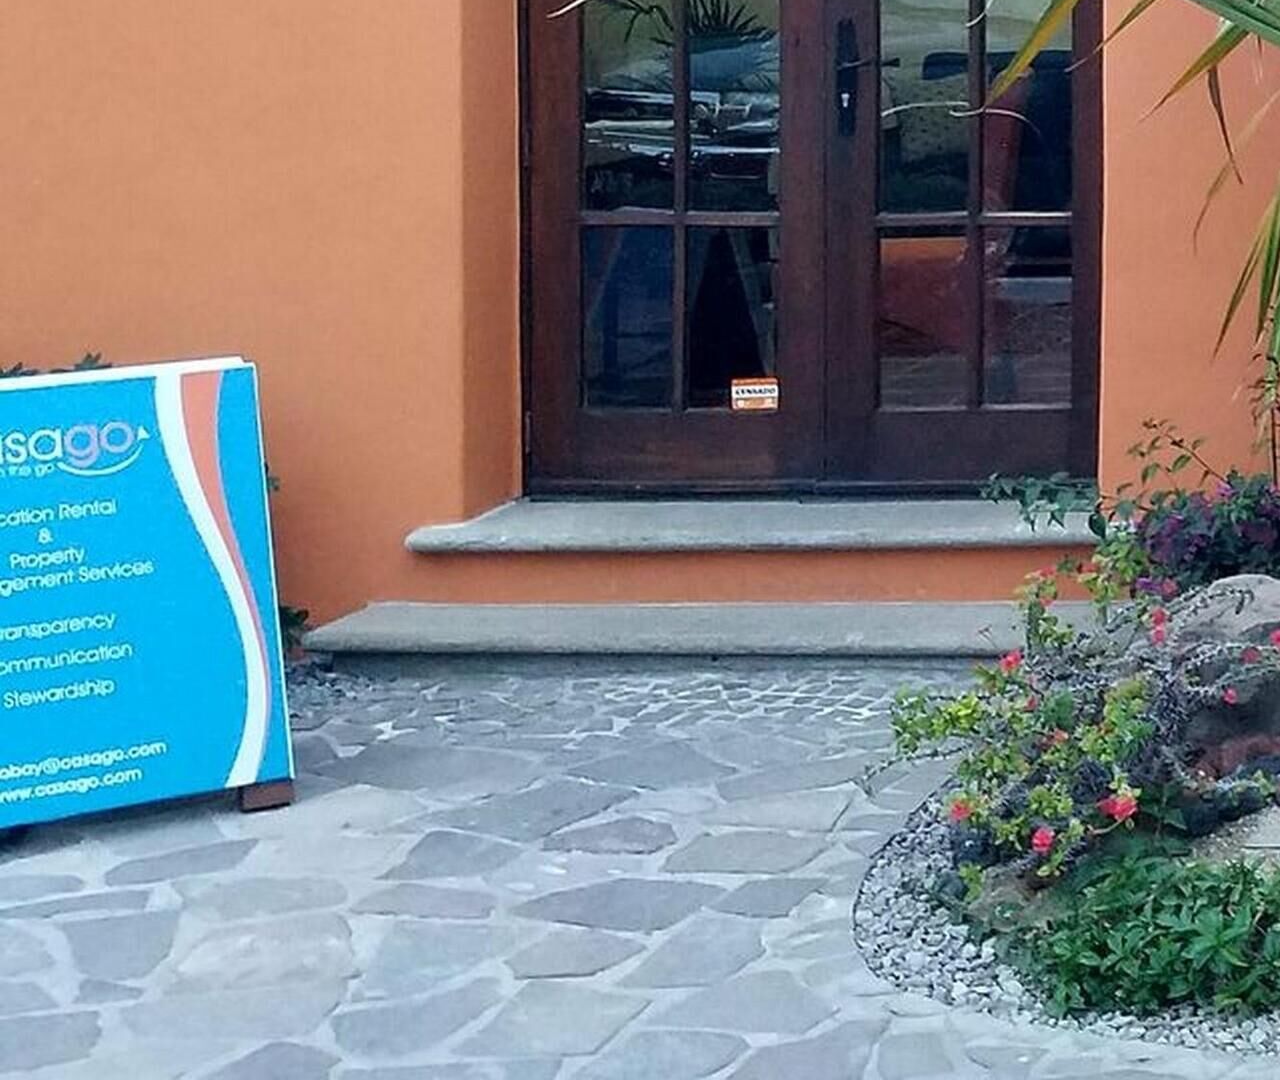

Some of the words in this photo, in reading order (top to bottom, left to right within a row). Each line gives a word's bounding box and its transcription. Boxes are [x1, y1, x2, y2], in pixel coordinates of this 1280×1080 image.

[0, 421, 135, 469] sago
[58, 498, 118, 520] Rental
[37, 527, 54, 545] &
[9, 547, 86, 569] Property
[78, 560, 155, 583] Services
[3, 679, 115, 709] Stewardship
